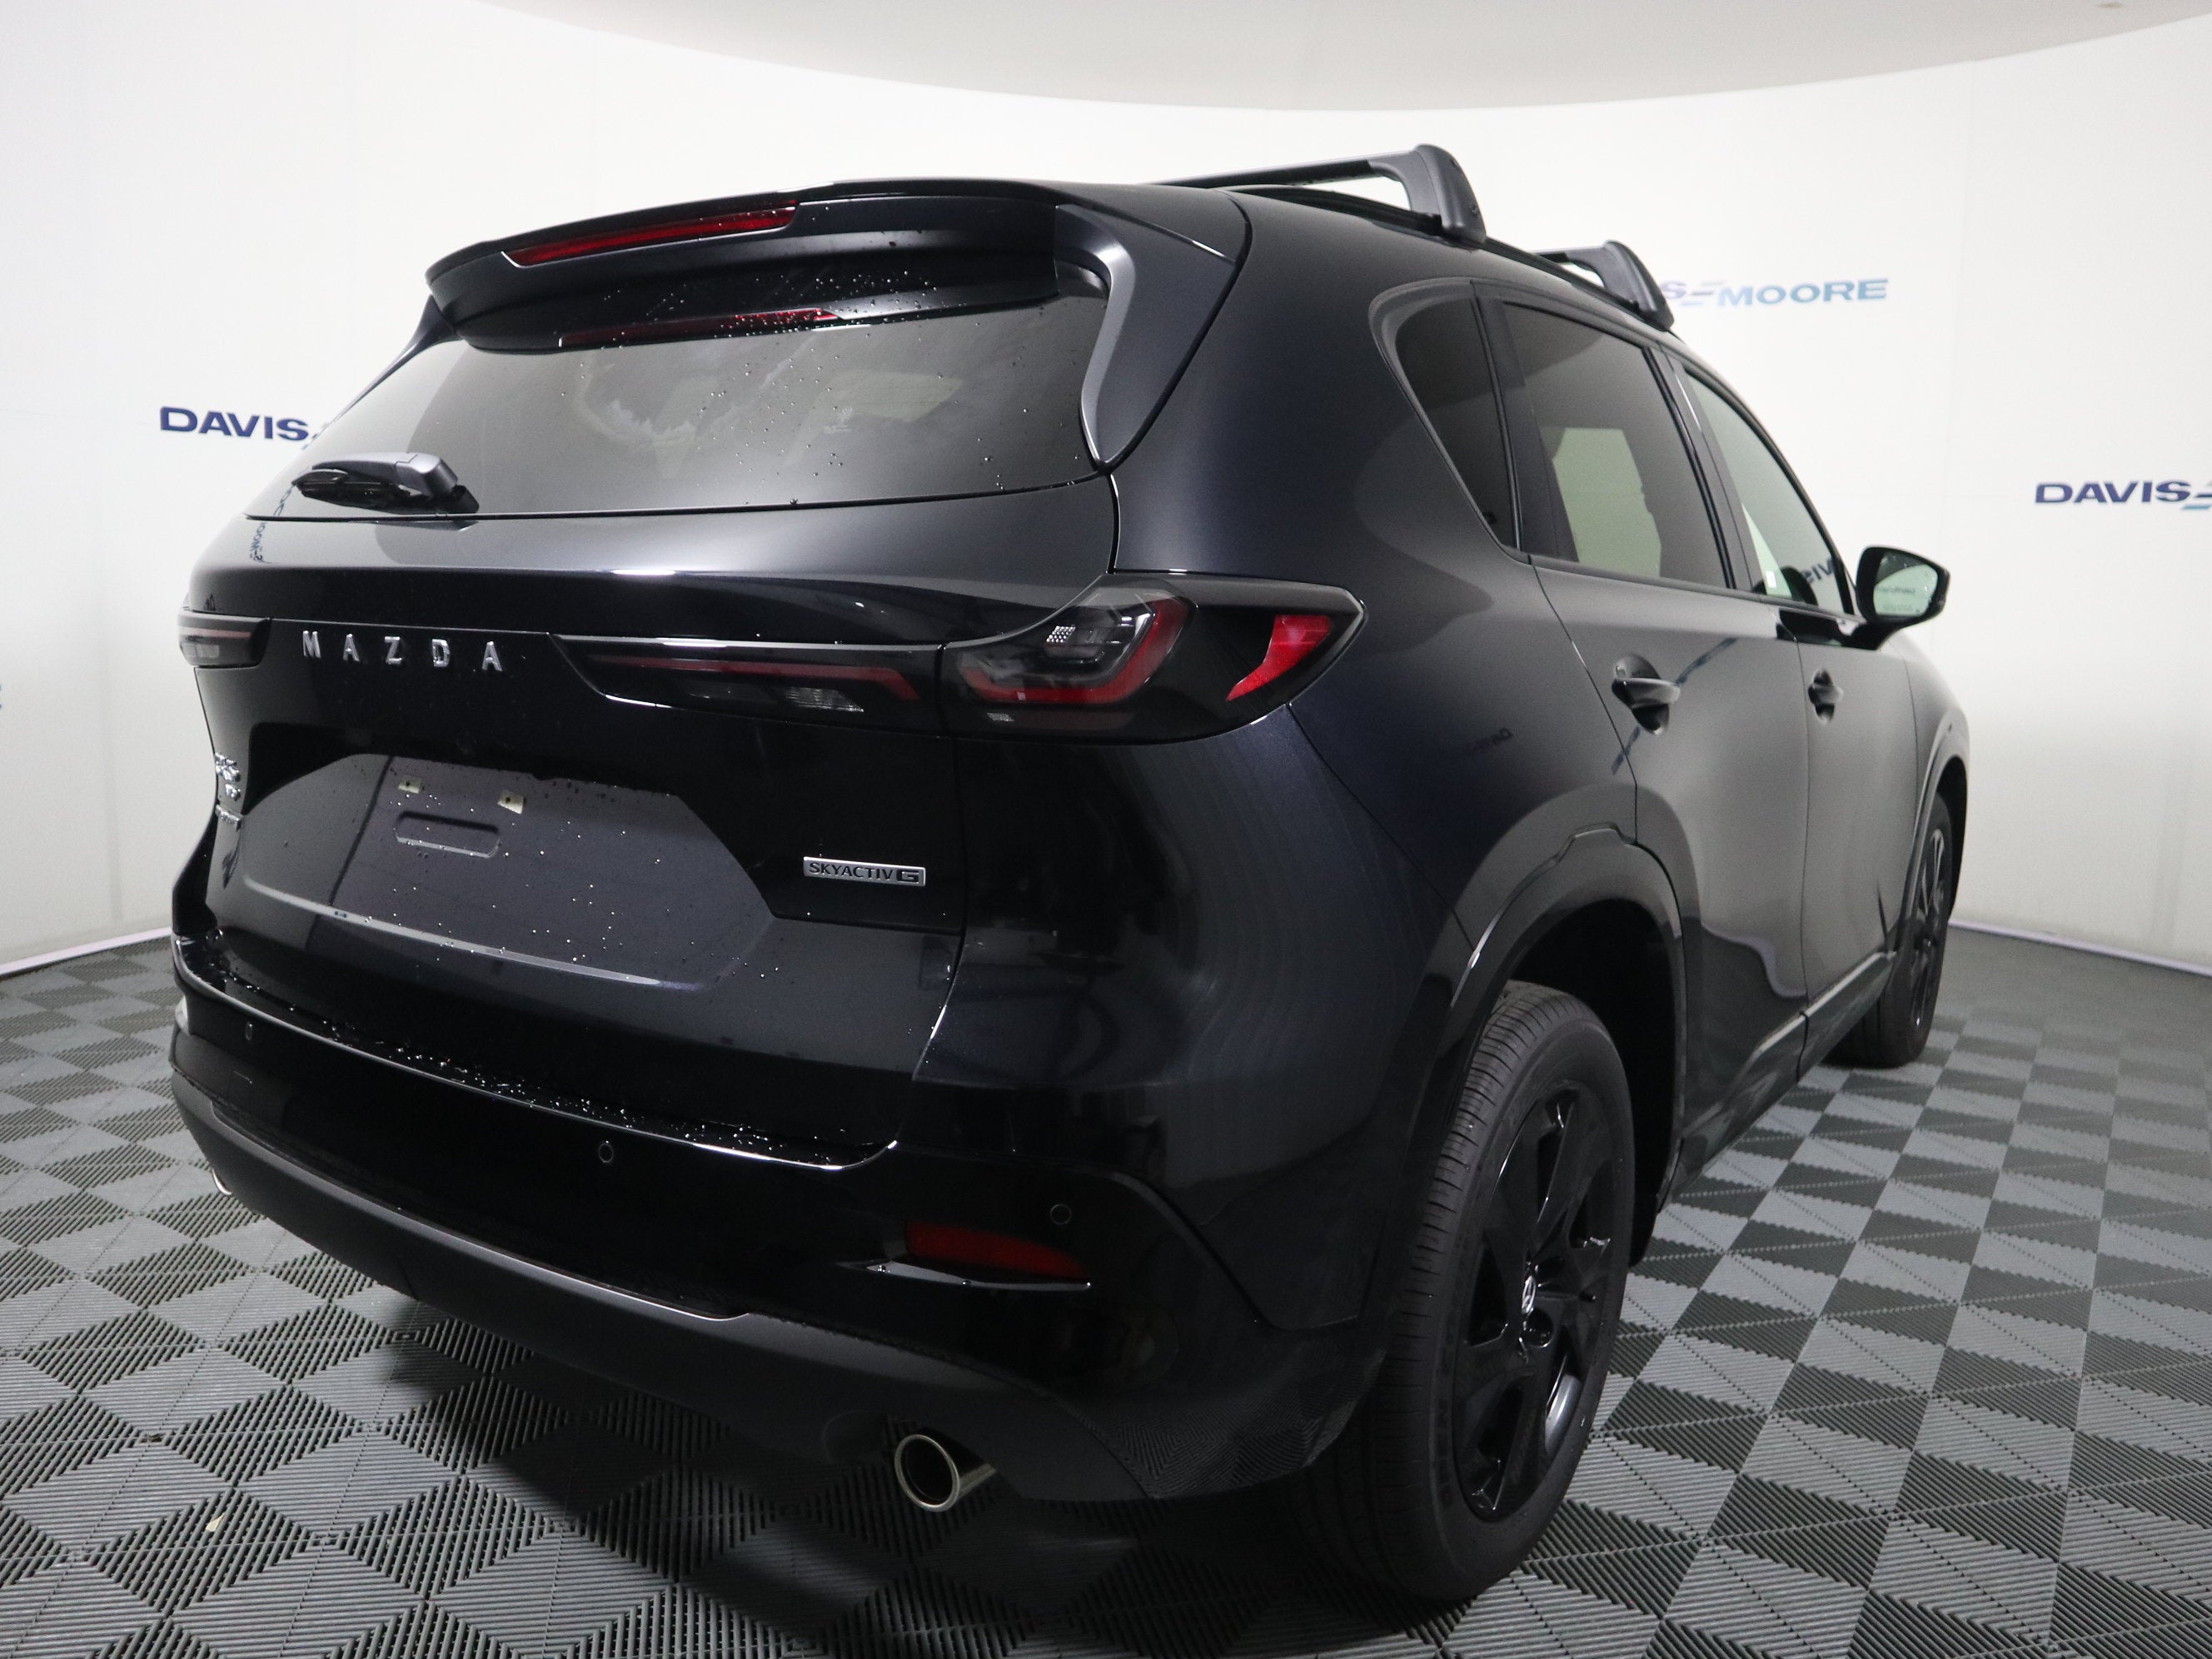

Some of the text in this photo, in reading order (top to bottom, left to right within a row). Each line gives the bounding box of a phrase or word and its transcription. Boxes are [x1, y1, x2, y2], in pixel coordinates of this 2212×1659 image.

[1717, 279, 1888, 306] MOORE
[160, 406, 309, 441] DAVIS
[2035, 481, 2191, 503] DAVIS
[302, 630, 503, 671] MAZDA
